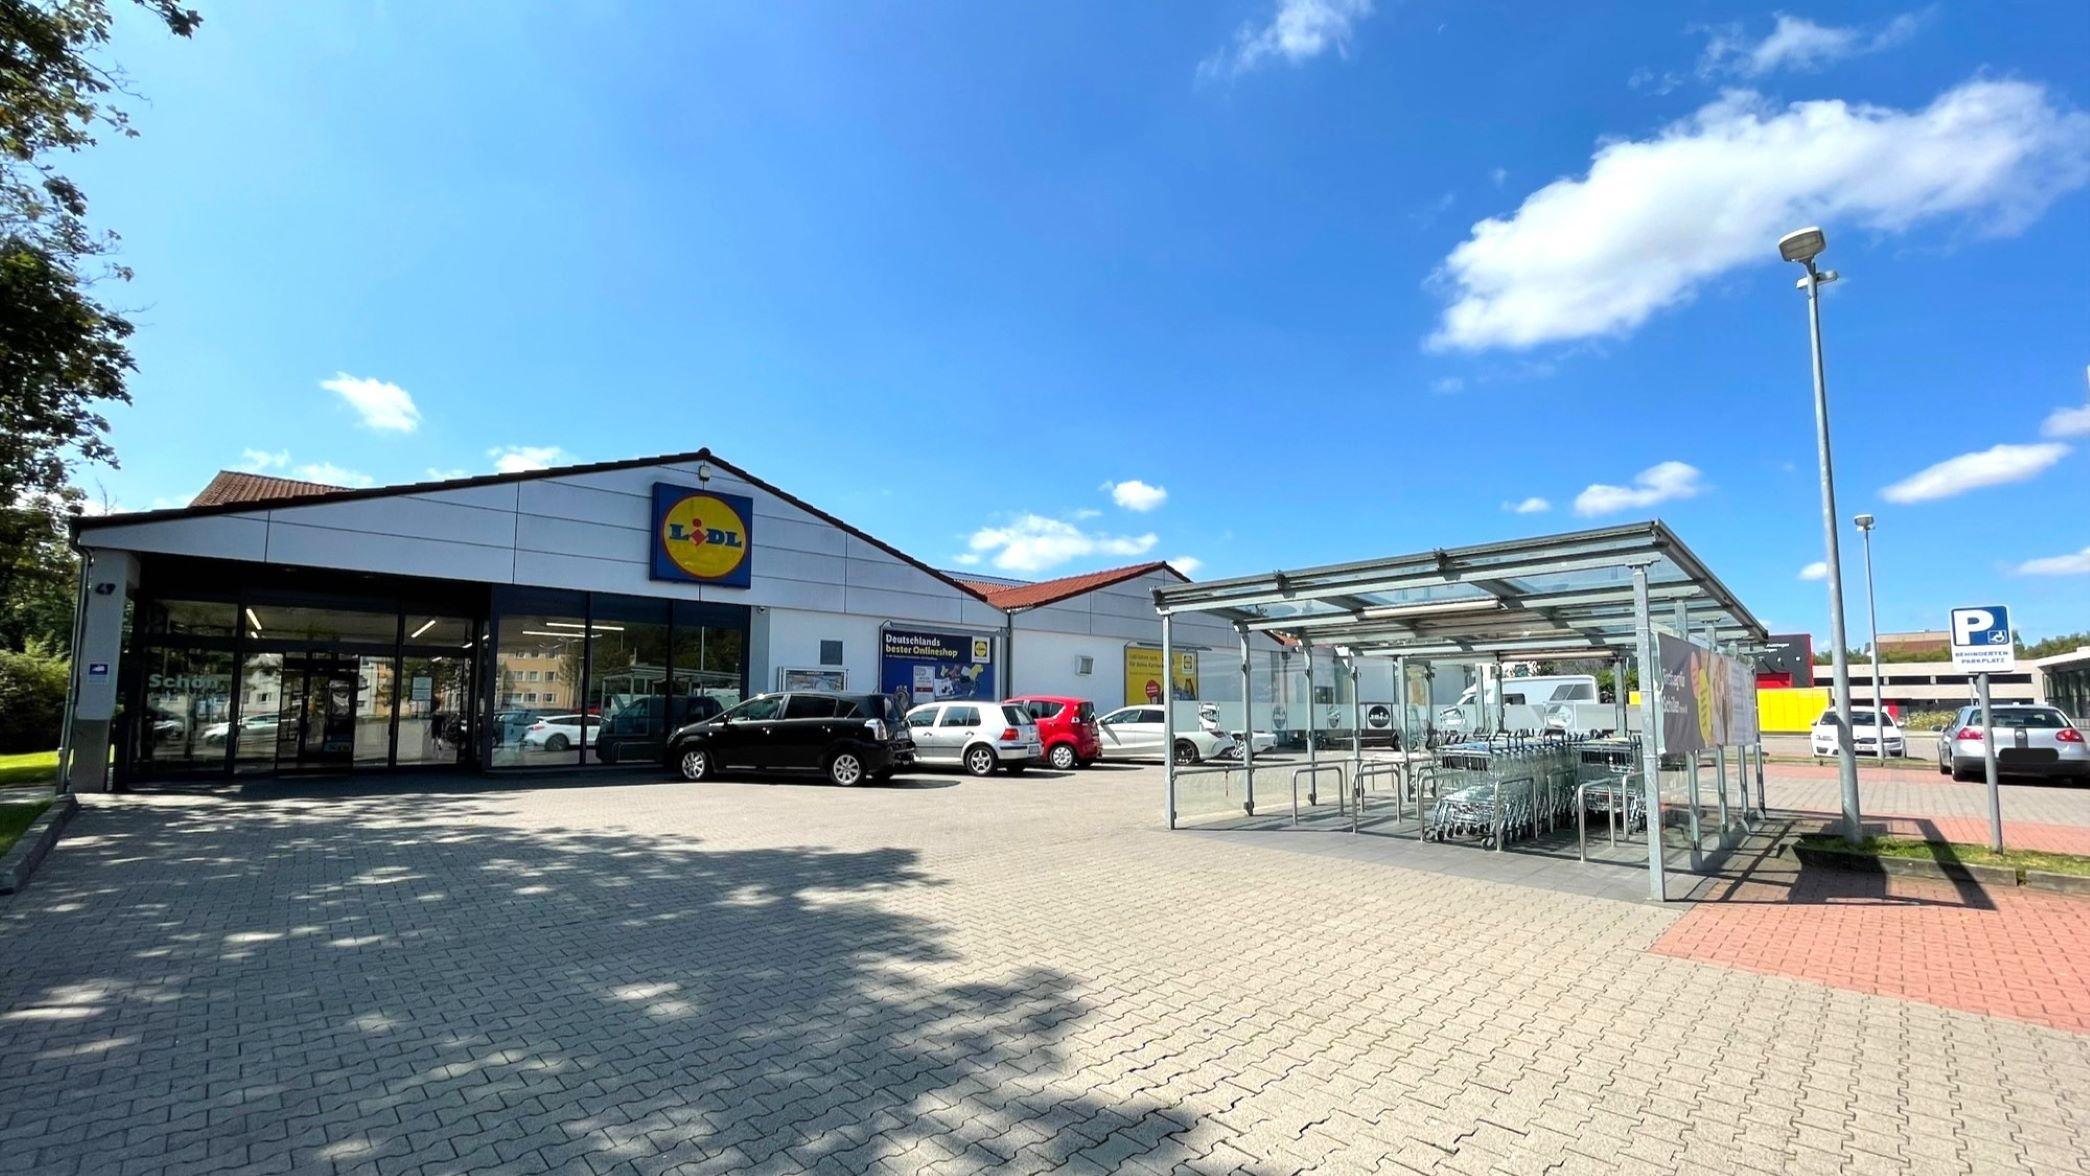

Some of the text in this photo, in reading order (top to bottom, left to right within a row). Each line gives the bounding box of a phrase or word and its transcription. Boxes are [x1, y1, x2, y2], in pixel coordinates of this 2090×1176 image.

[1953, 609, 1995, 645] P
[885, 634, 941, 647] Deutschlands
[885, 645, 912, 654] bester
[912, 646, 958, 658] Onlineshop
